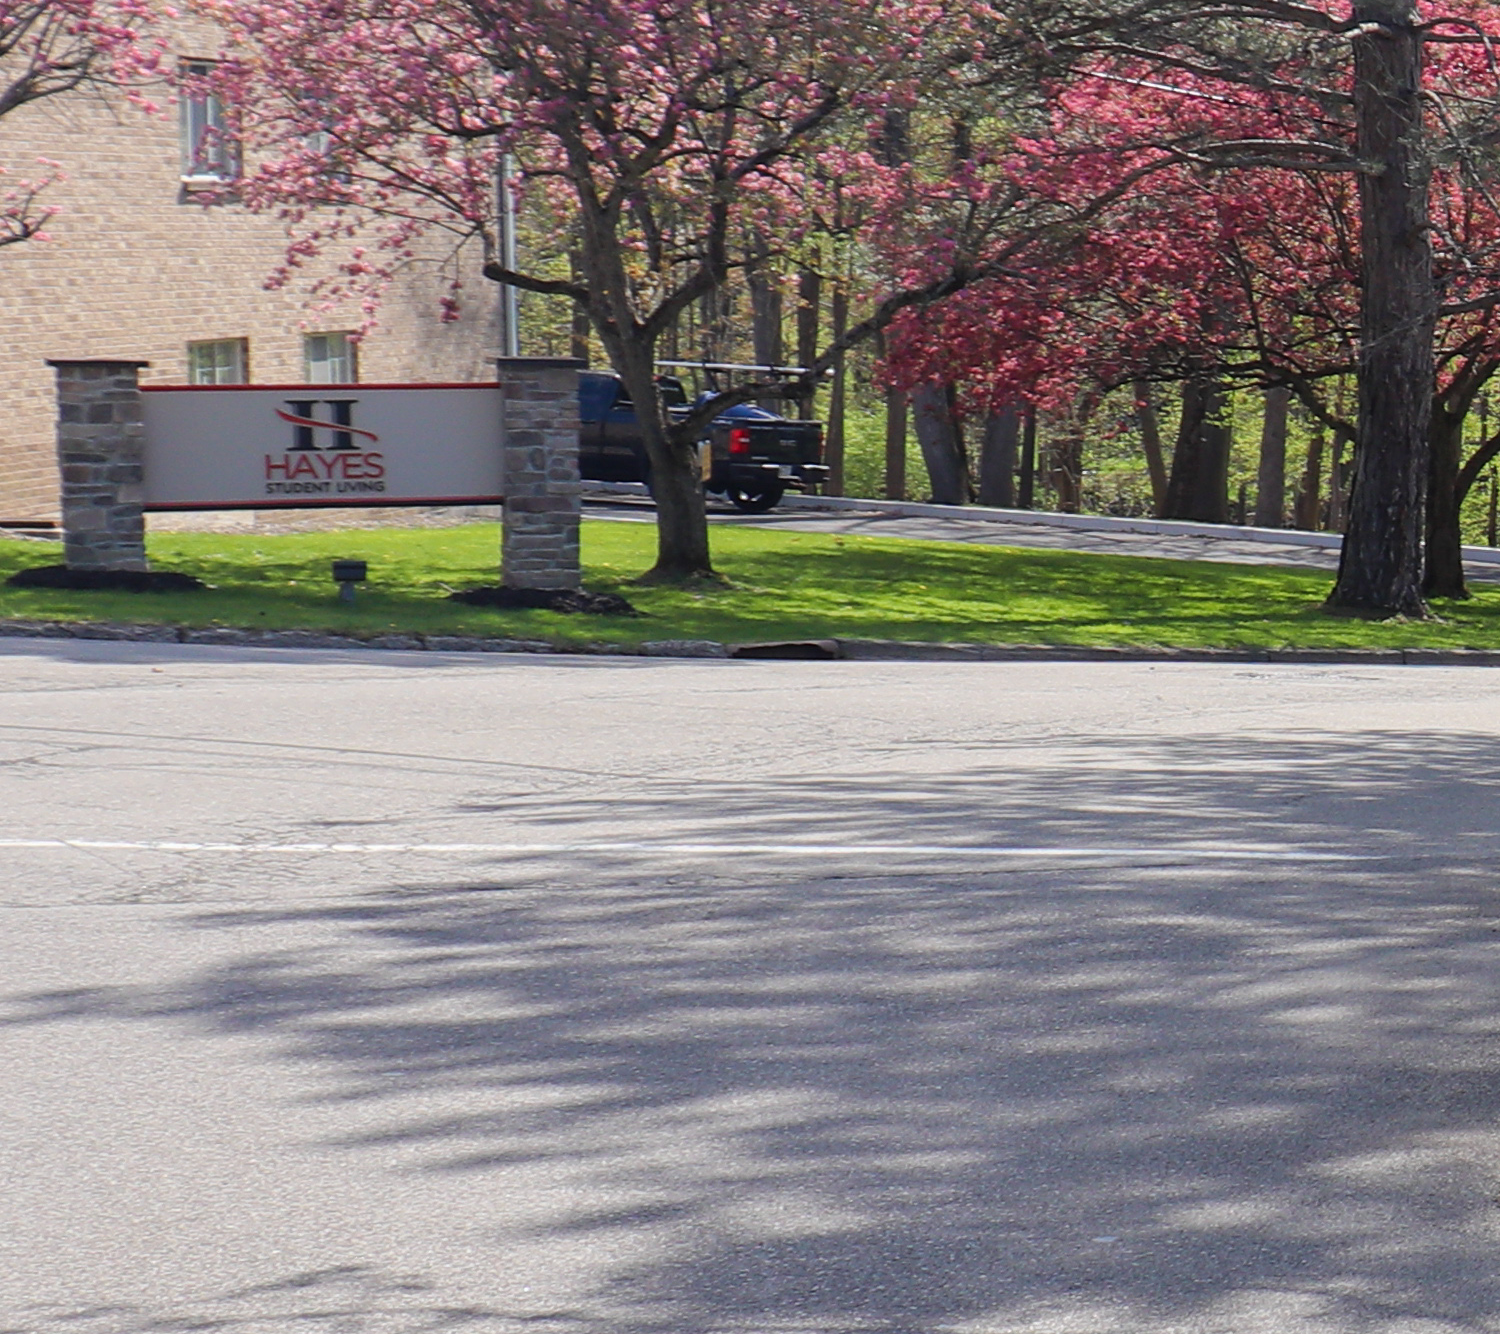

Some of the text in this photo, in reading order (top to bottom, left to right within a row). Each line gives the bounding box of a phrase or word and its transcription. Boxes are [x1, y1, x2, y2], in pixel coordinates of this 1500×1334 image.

[264, 452, 385, 480] HAYES
[266, 481, 385, 494] STUDENT LIVING
